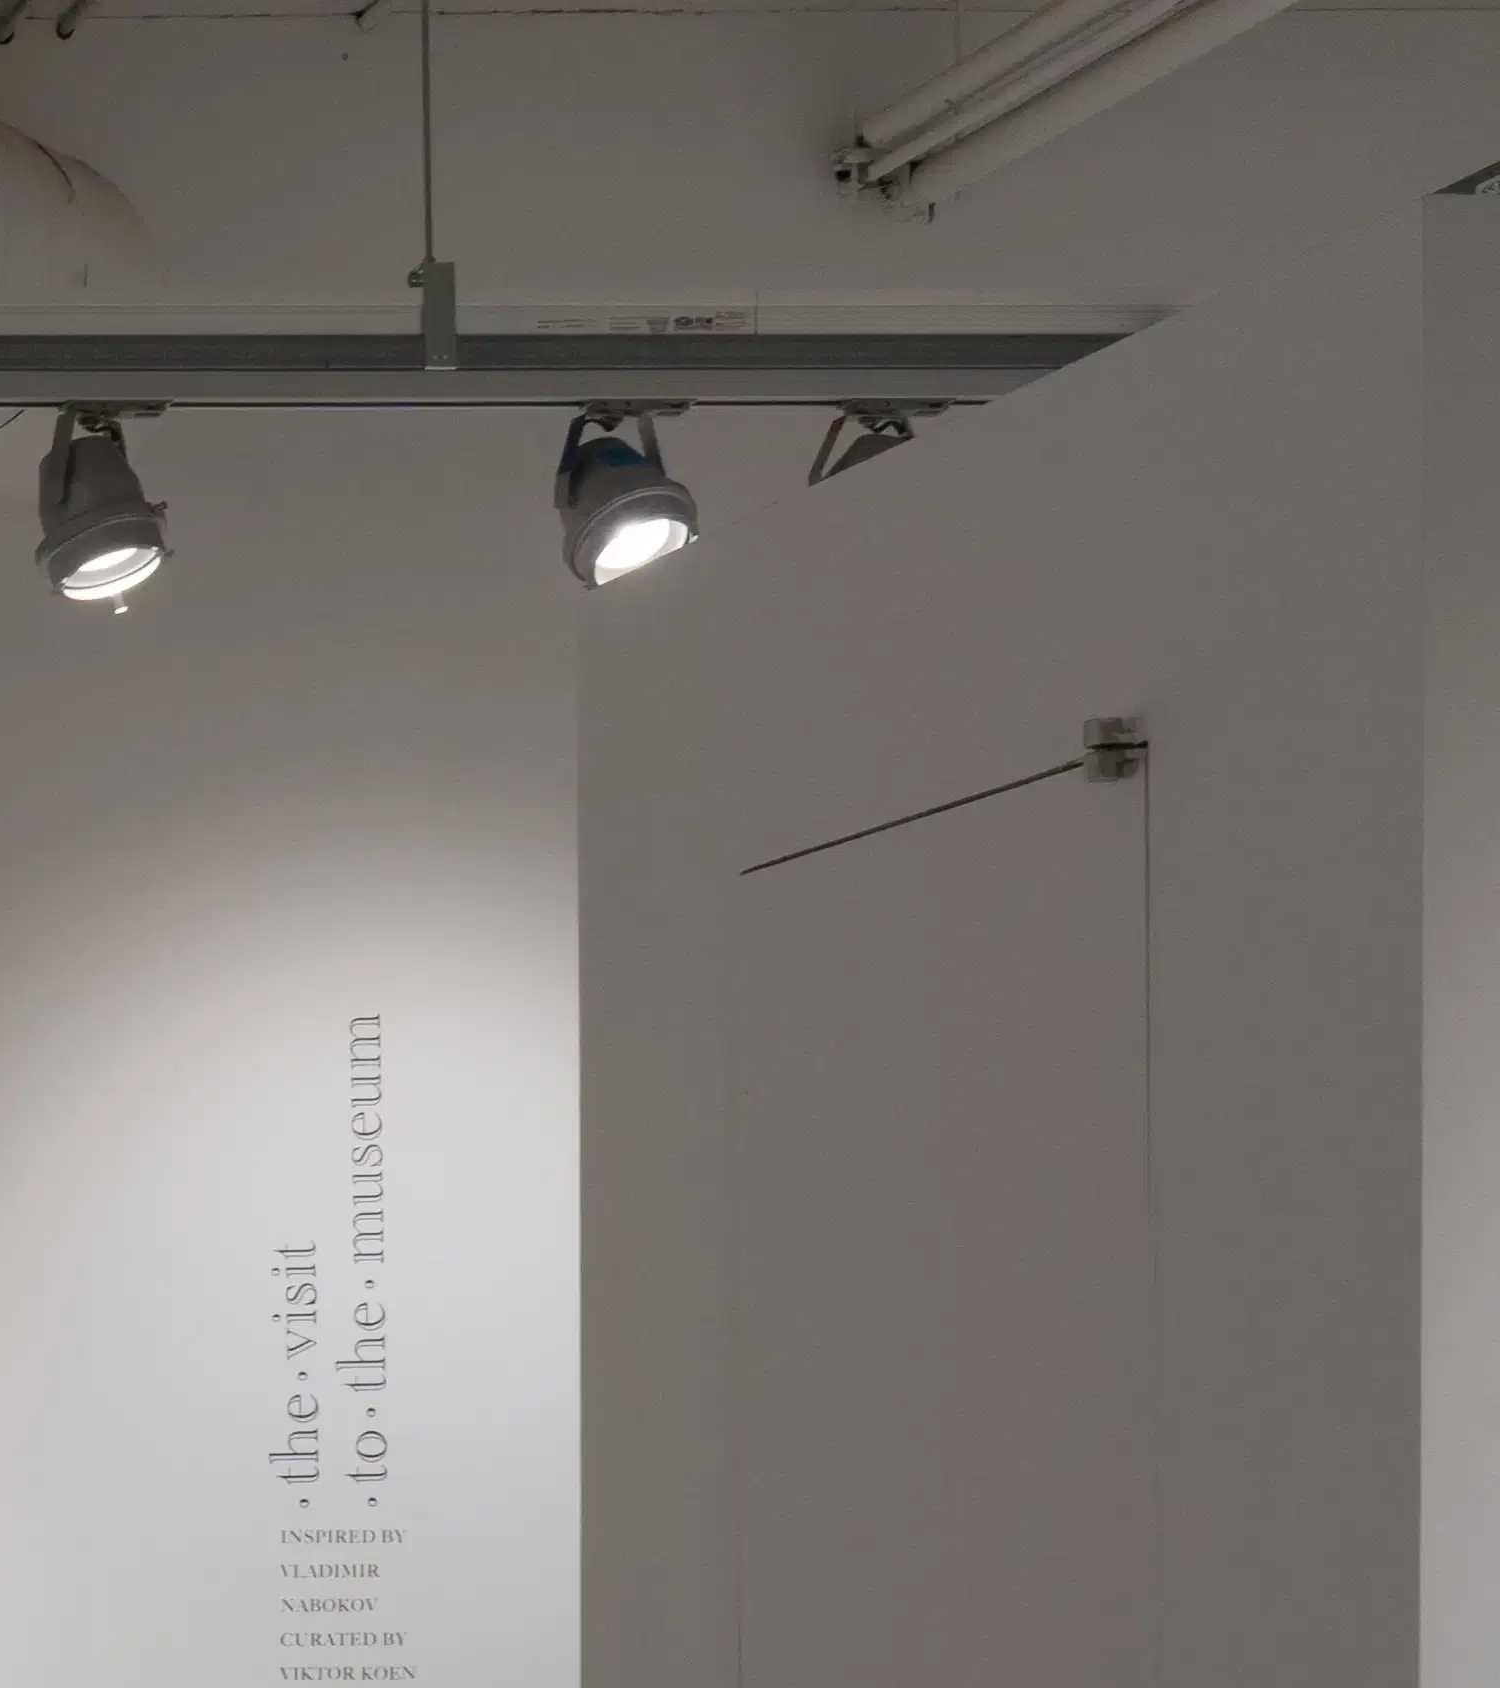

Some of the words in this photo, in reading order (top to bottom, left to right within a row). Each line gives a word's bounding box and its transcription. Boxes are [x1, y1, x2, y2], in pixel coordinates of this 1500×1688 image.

[350, 1013, 385, 1264] museum
[272, 1240, 318, 1361] visit
[335, 1302, 387, 1392] the
[269, 1394, 320, 1485] the
[344, 1430, 388, 1484] to
[280, 1529, 376, 1544] INSPIRED
[381, 1529, 407, 1544] BY
[280, 1563, 380, 1578] VLADIMIR
[280, 1598, 378, 1613] NABOKOV
[280, 1632, 377, 1647] CURATED
[383, 1632, 407, 1646] BY
[279, 1667, 355, 1681] VIKTOR
[361, 1667, 417, 1681] KOEN
